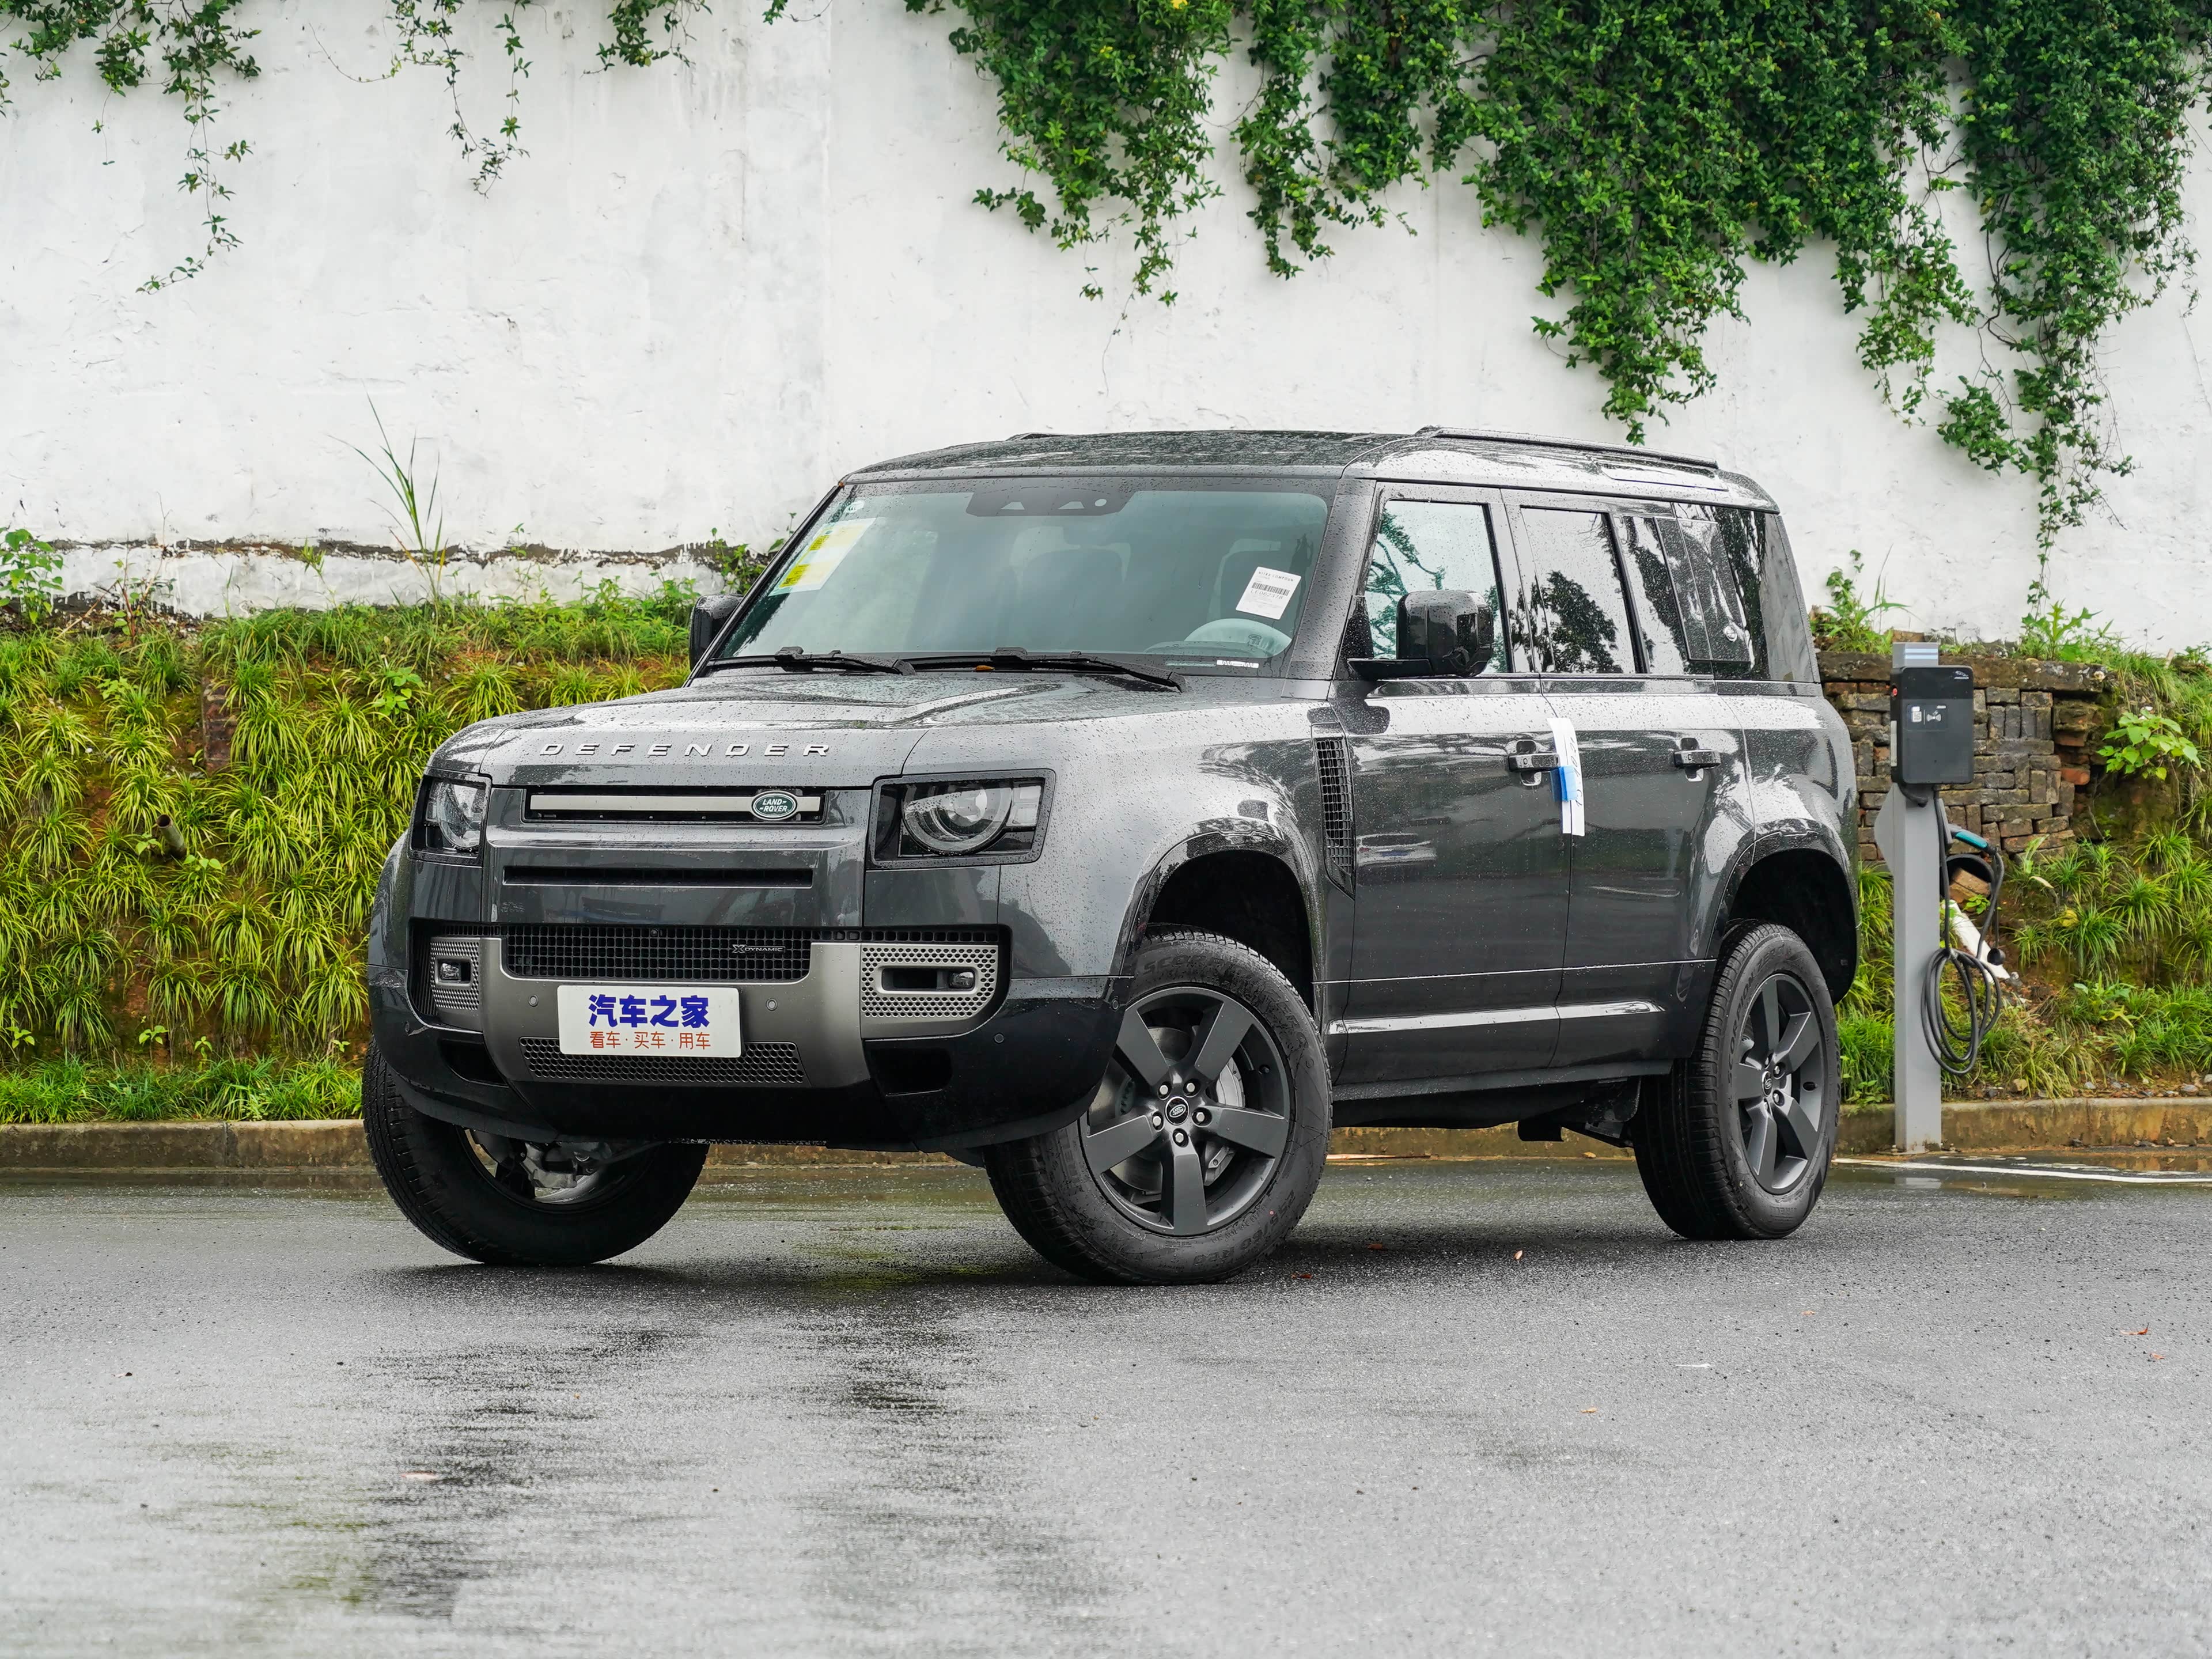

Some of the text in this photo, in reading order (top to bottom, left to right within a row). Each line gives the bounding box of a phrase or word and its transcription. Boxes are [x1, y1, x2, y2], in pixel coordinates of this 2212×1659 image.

[539, 743, 831, 756] DEFENDER
[588, 994, 710, 1028] 汽车之家
